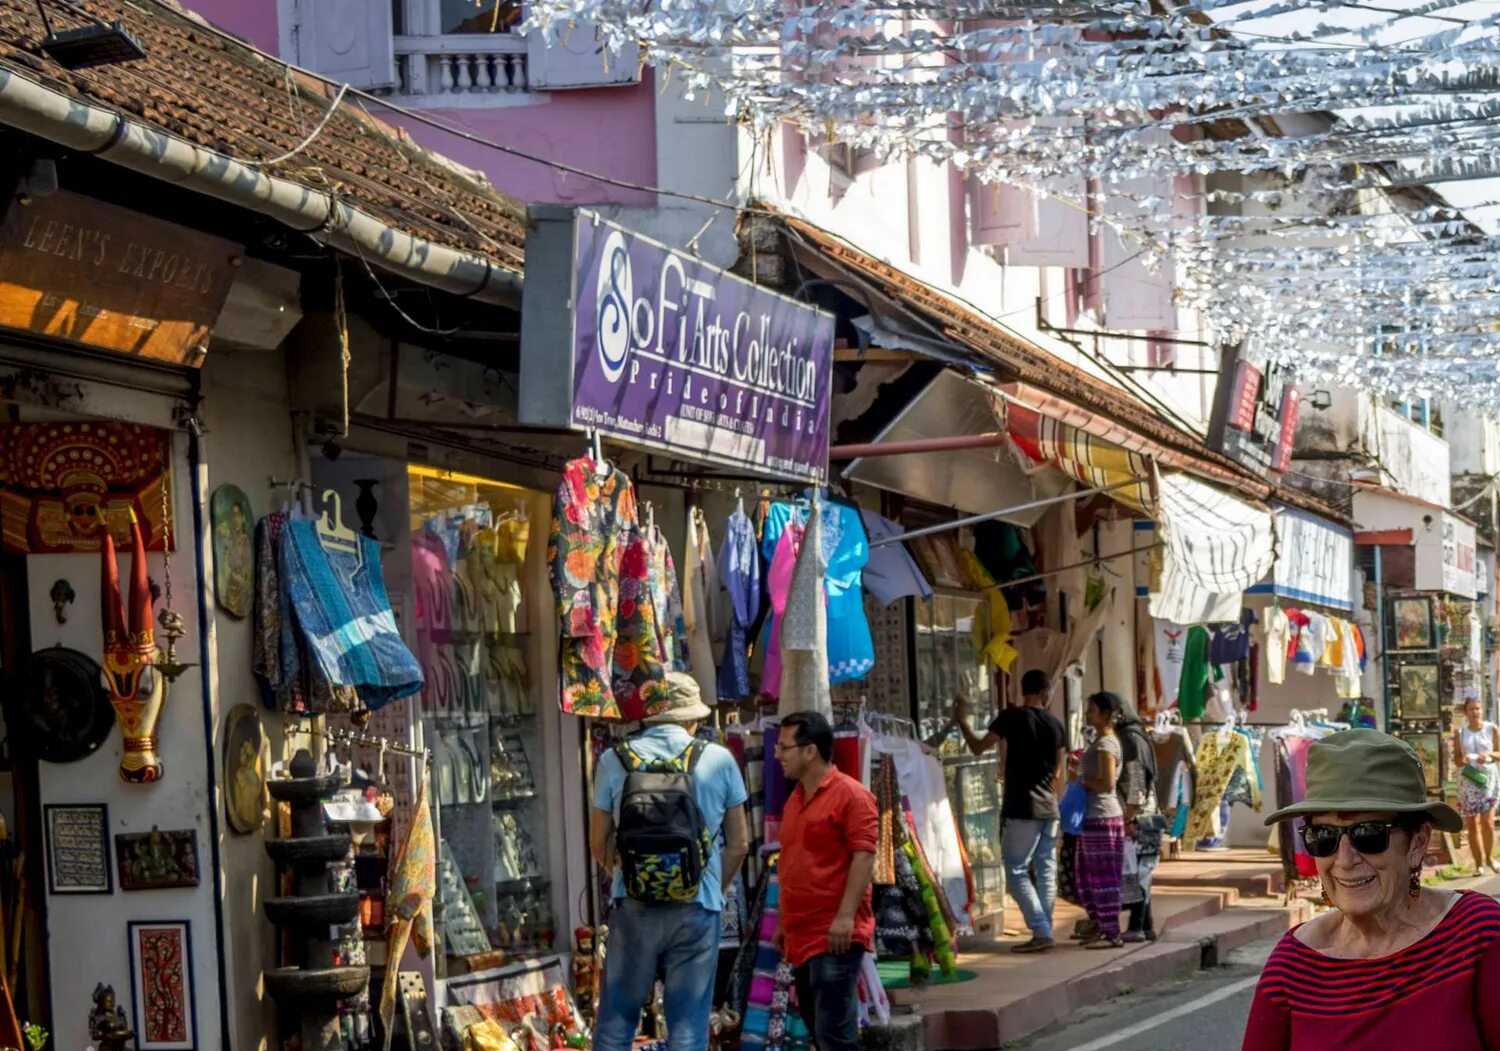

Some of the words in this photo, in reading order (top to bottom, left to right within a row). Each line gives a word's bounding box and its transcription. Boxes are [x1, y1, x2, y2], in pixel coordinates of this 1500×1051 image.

[630, 359, 709, 404] Pride
[720, 390, 743, 414] of
[752, 395, 815, 434] India
[733, 311, 817, 402] Collection
